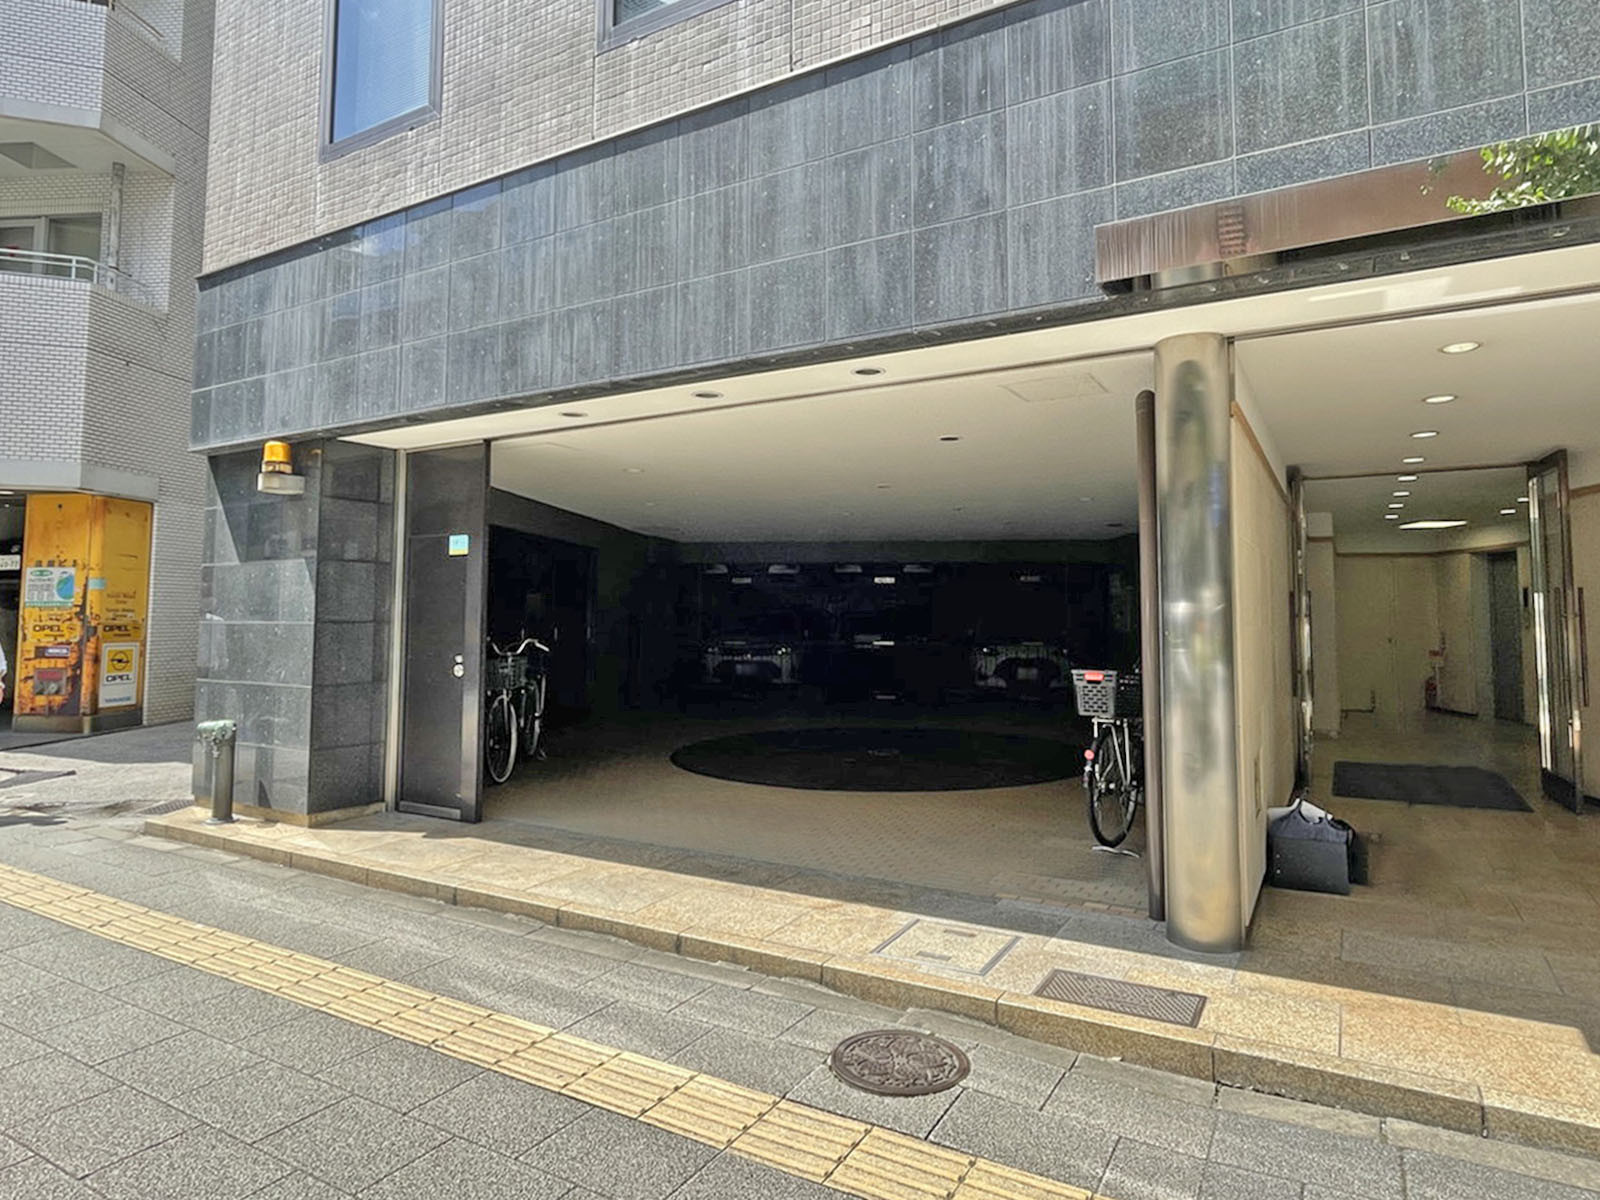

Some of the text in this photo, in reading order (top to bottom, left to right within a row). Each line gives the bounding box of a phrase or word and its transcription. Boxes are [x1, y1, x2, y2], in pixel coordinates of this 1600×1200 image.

[33, 624, 64, 632] OPEL
[103, 624, 130, 632] OPEL
[105, 673, 133, 682] OPEL
